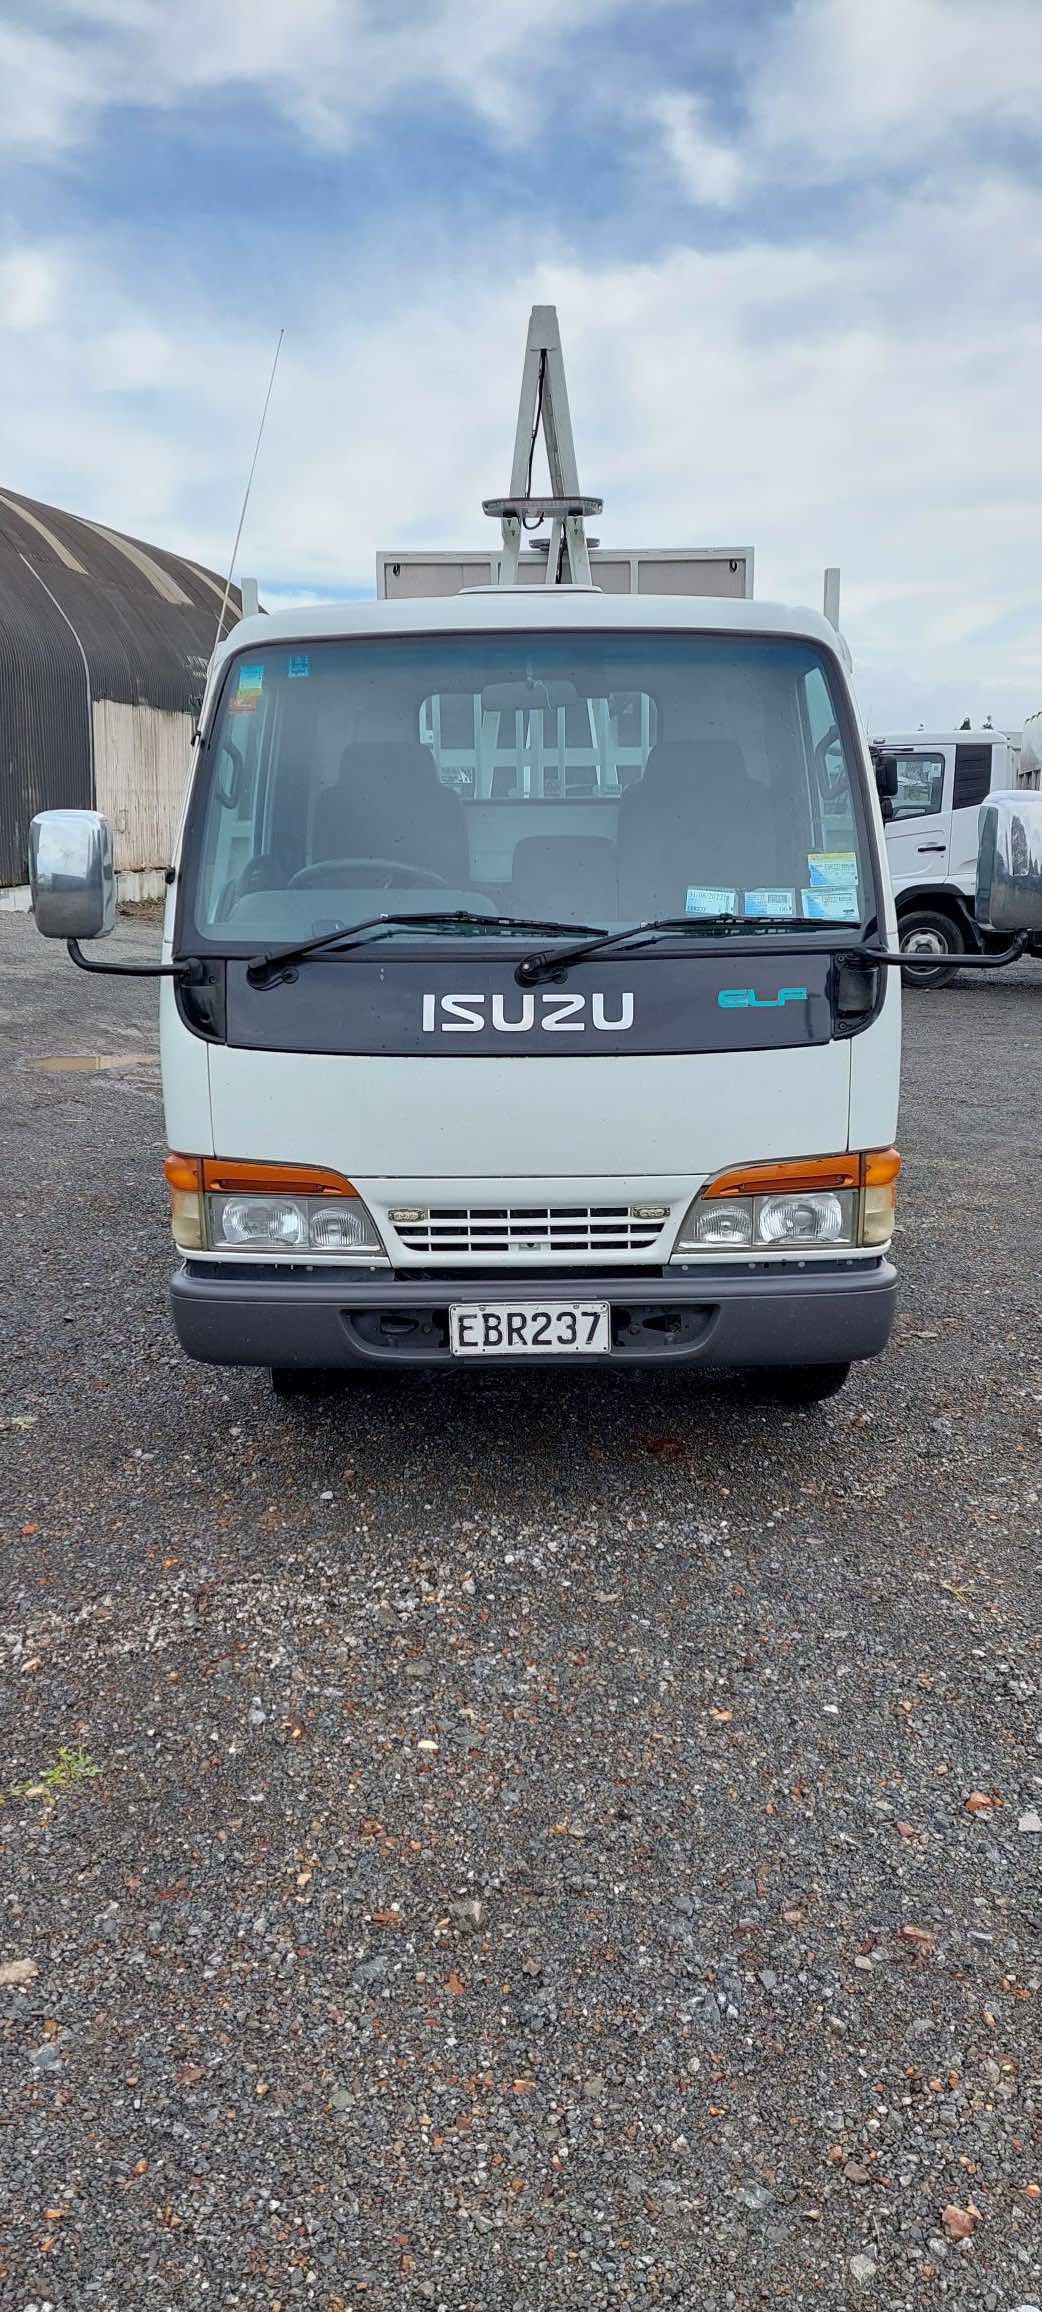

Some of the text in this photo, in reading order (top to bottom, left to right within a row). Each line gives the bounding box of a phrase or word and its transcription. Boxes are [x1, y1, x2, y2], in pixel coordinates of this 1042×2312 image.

[422, 993, 634, 1032] ISUZU
[717, 987, 809, 1009] ELF
[458, 1311, 602, 1348] EBR237
